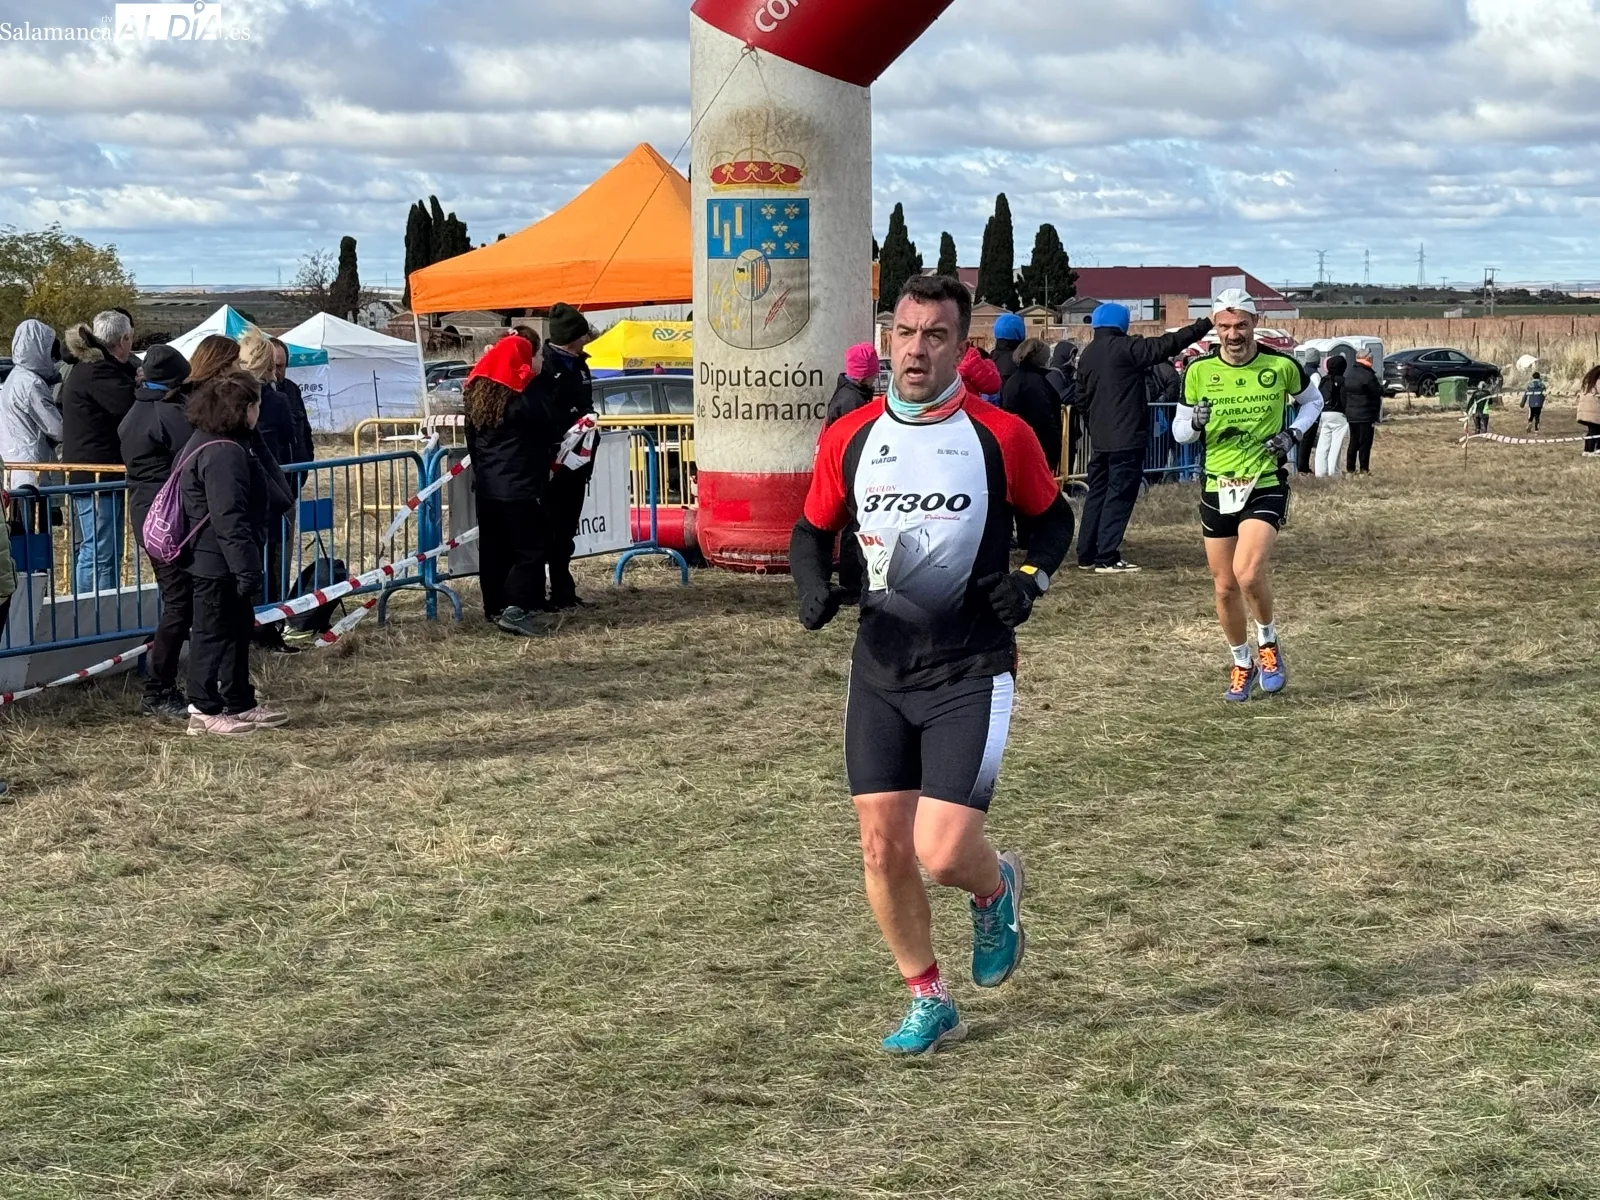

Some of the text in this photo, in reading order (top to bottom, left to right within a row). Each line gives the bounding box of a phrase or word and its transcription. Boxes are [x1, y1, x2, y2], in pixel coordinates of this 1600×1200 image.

[754, 0, 800, 33] CO
[700, 361, 824, 392] Diputación
[696, 395, 827, 421] de Salamanc
[1208, 393, 1280, 406] ORRECAMINOS
[1215, 405, 1273, 417] CARBAJOSA
[871, 455, 897, 465] VIATOR
[863, 492, 972, 513] 37300
